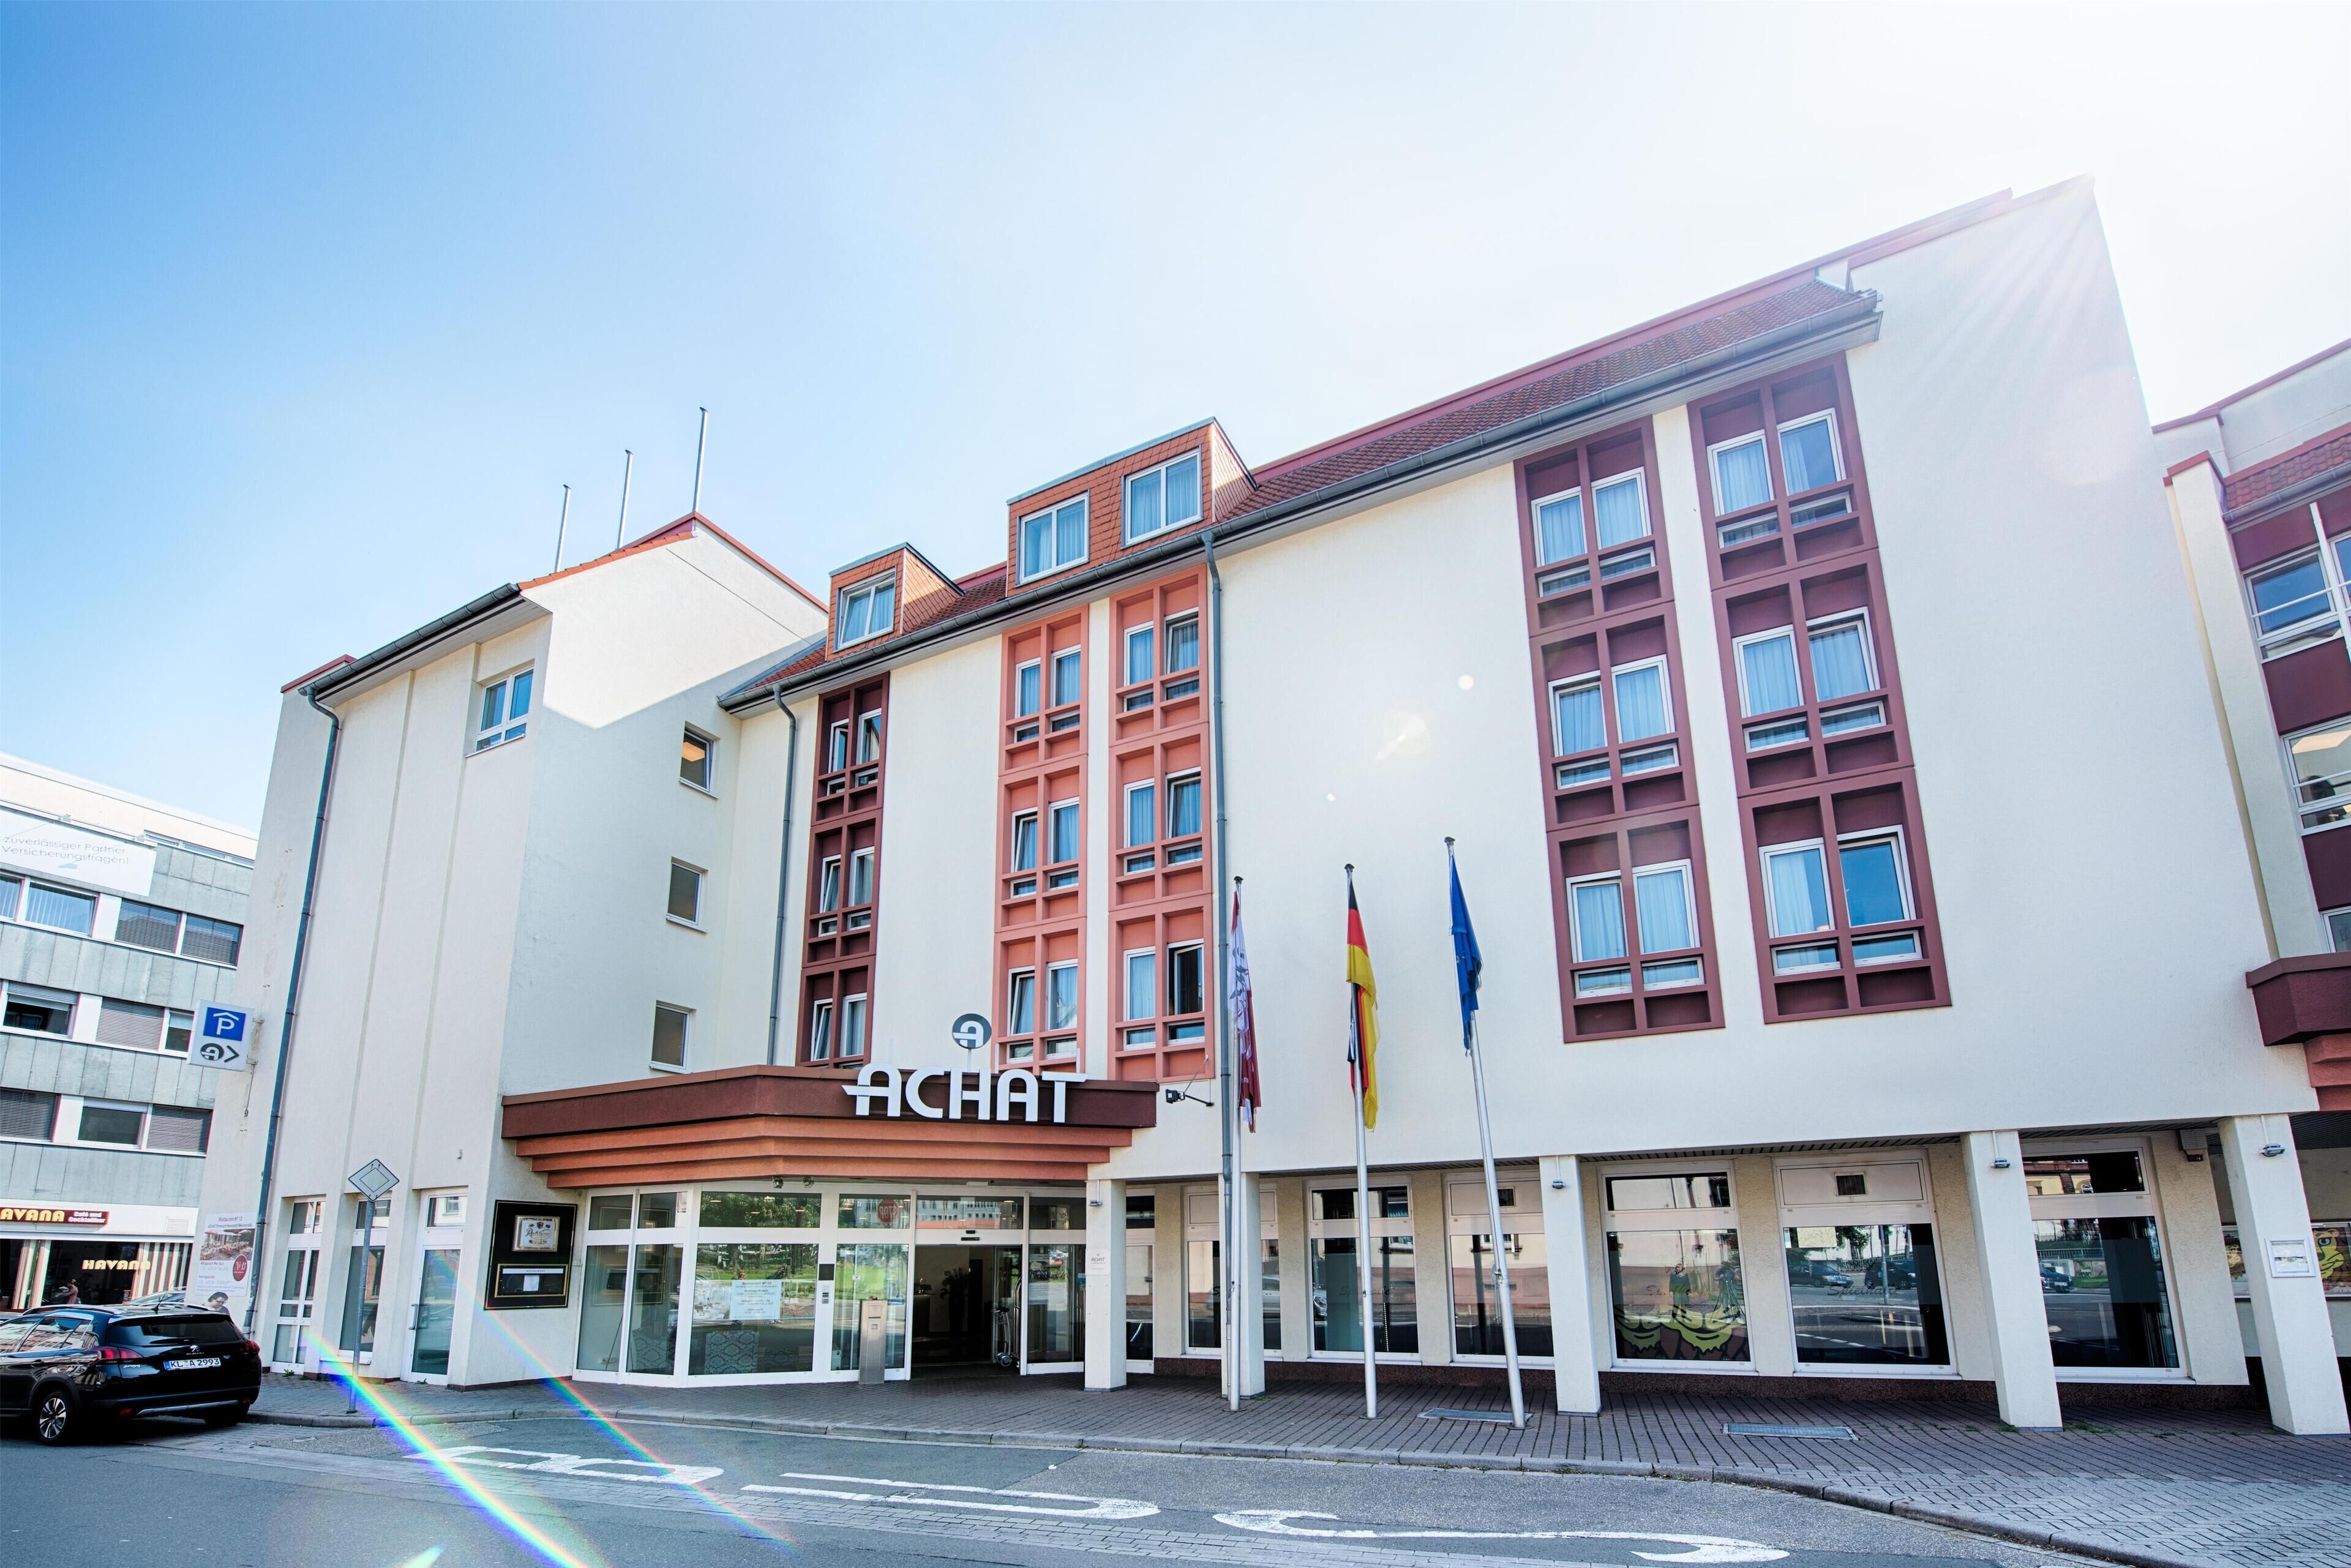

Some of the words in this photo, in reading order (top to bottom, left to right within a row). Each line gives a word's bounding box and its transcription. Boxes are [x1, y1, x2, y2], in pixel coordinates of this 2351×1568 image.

[4, 837, 81, 850] zuverlässiger
[85, 843, 126, 854] Partner
[2, 846, 129, 864] Versicherungsfragen!
[216, 1017, 234, 1035] P
[841, 1062, 1090, 1123] ACHAT
[81, 1259, 151, 1270] HAVANA
[170, 1360, 183, 1369] KL
[197, 1358, 220, 1367] 2993
[401, 1446, 1791, 1563] BUS
